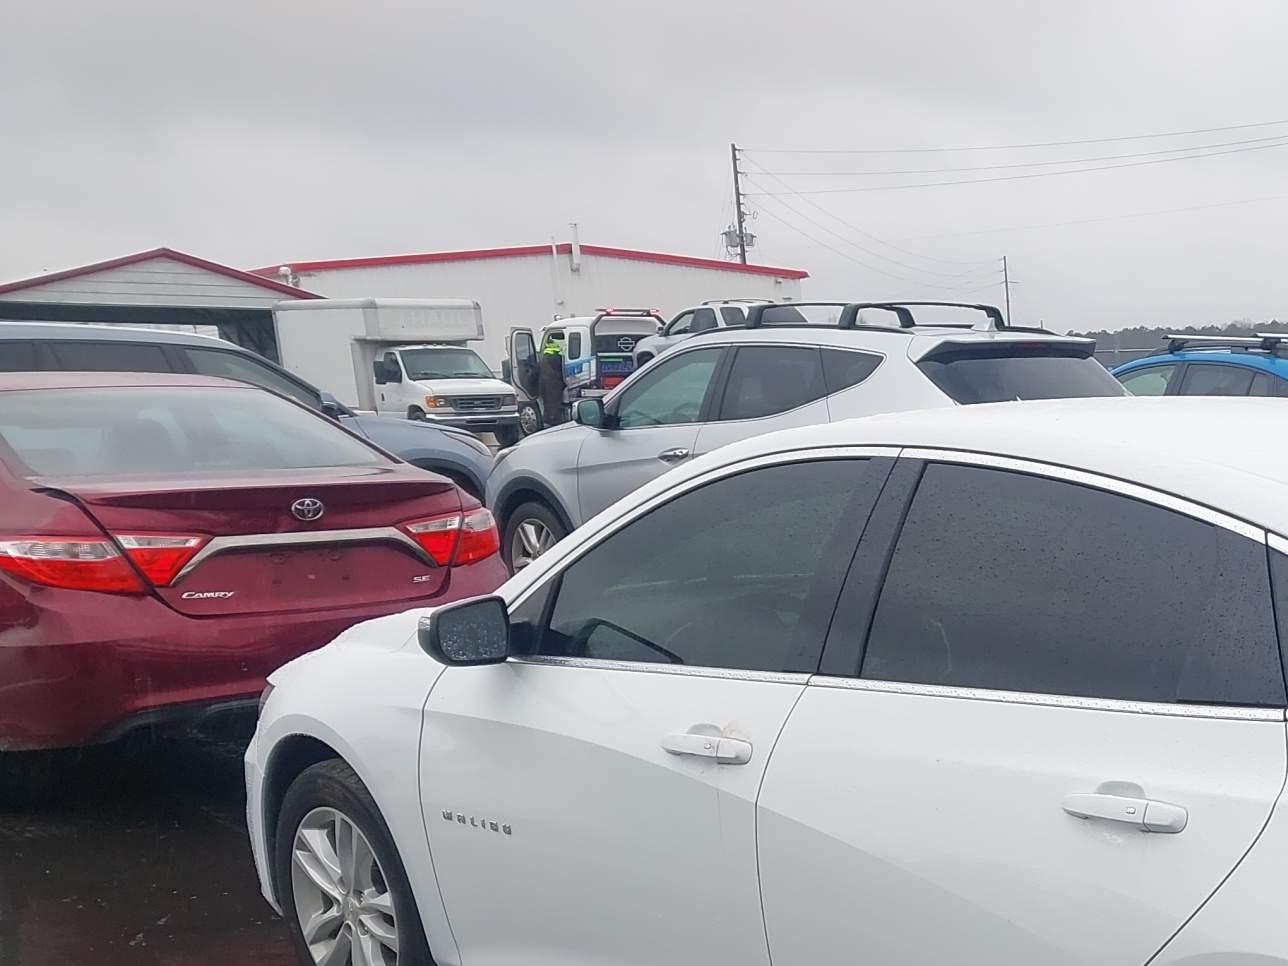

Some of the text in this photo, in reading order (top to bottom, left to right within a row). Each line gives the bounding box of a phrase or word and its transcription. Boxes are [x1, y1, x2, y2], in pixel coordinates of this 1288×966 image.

[412, 574, 432, 584] SE
[181, 591, 235, 600] CAMRY
[441, 810, 512, 835] MALIBU
